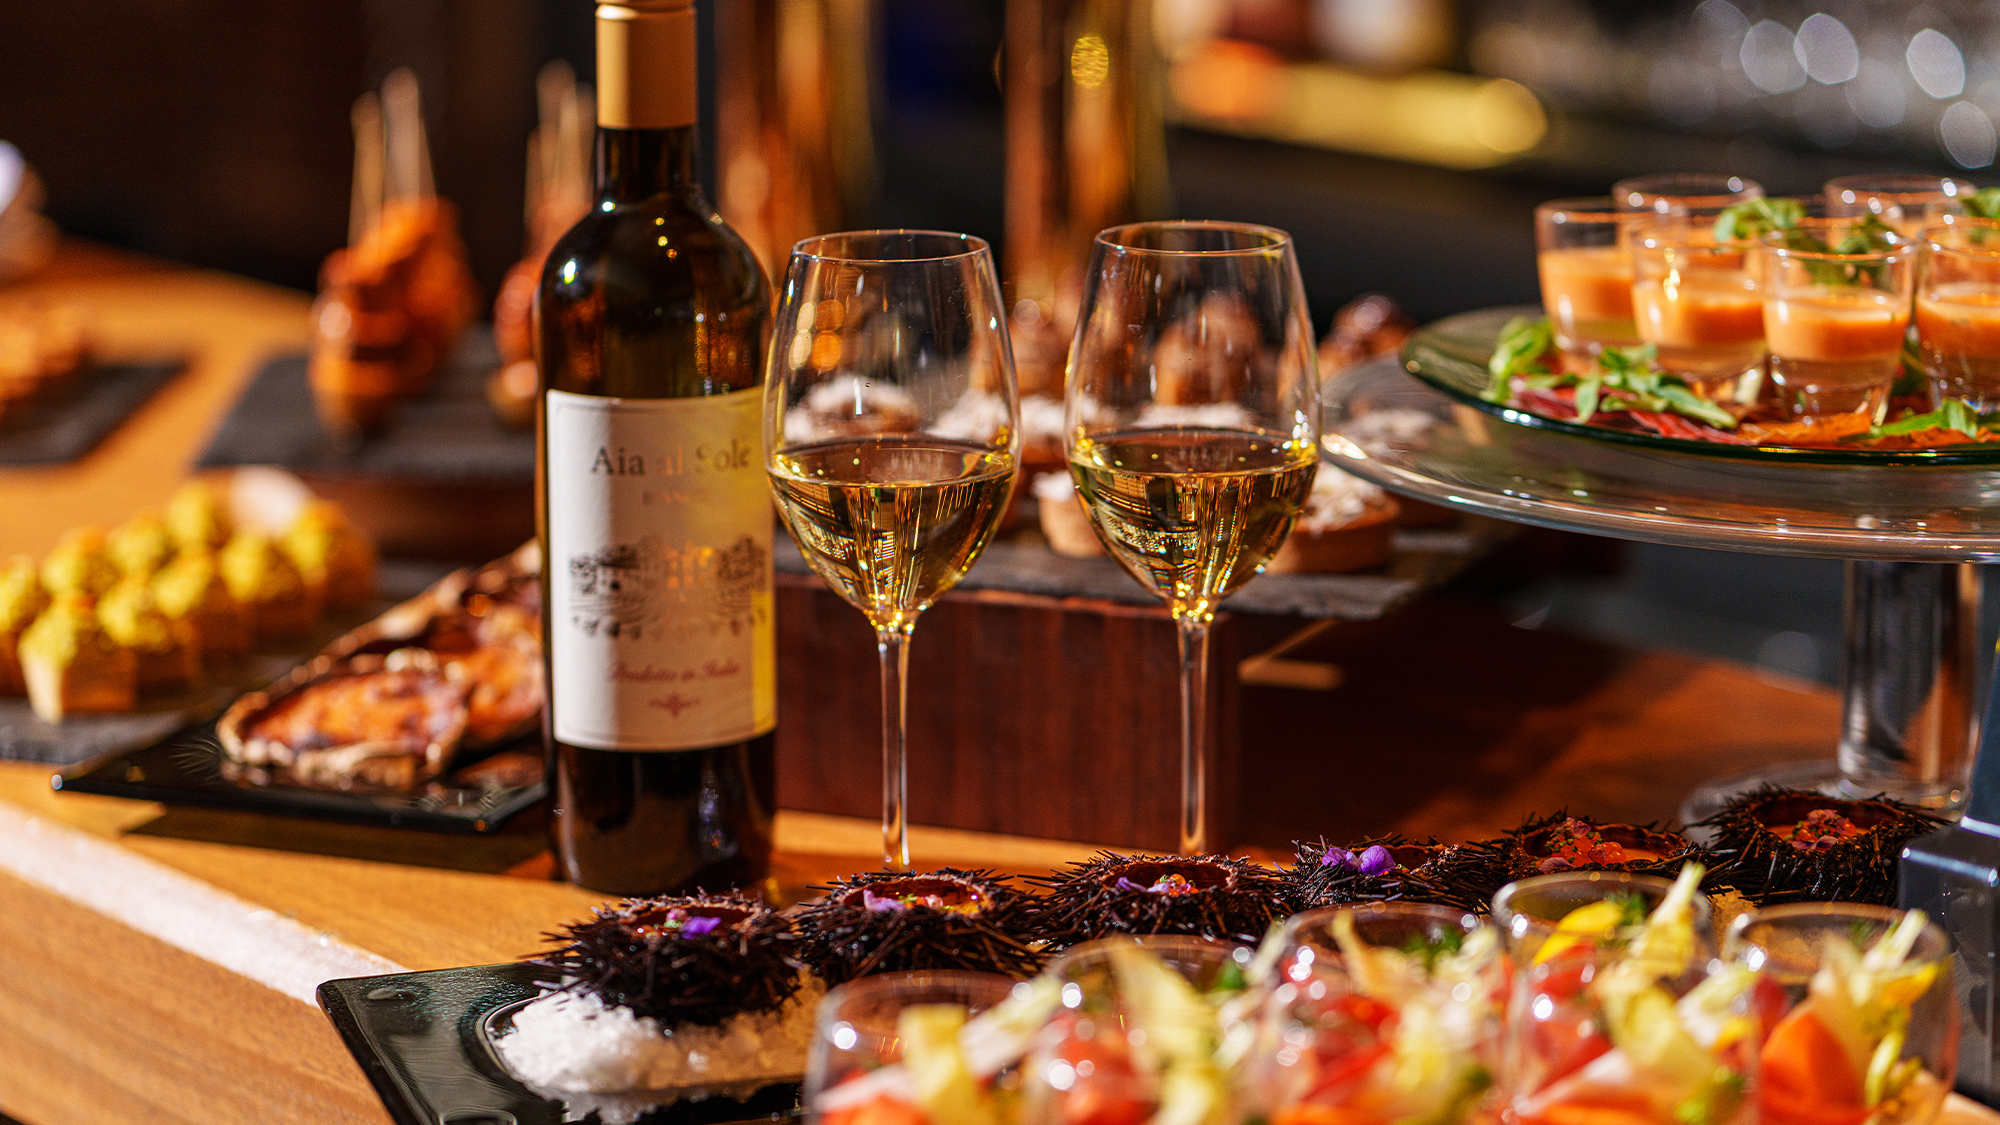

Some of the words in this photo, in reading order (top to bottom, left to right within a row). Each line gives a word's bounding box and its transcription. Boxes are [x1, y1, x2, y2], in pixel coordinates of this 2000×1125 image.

[590, 445, 646, 476] Aia
[656, 444, 685, 476] al
[694, 437, 752, 474] Sole
